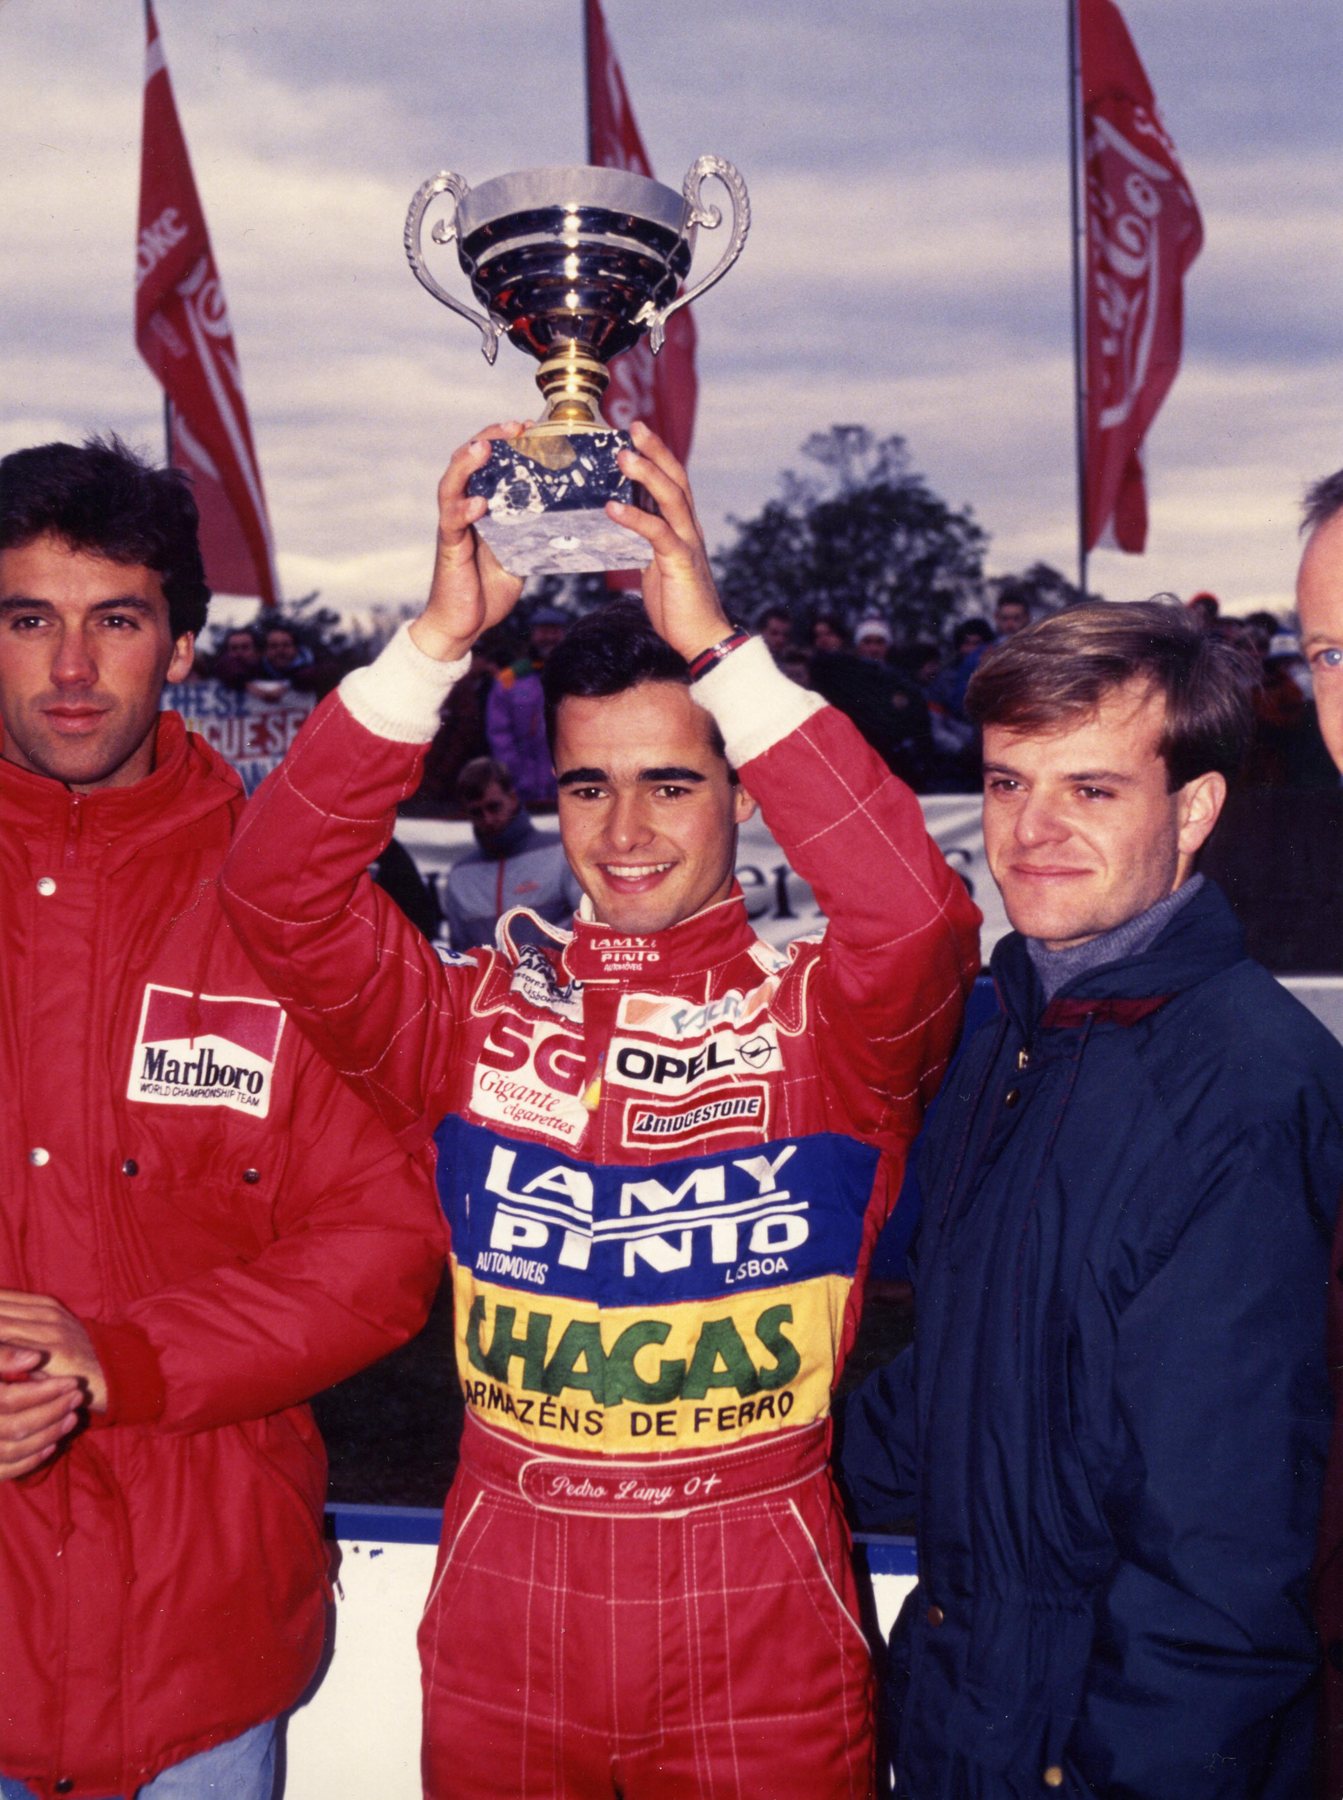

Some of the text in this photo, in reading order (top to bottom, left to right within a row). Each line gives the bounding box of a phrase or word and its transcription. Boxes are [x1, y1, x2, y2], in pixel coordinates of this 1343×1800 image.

[590, 938, 650, 950] LAMY
[601, 950, 660, 962] PINTO
[141, 1046, 264, 1094] Marlboro
[480, 1011, 586, 1097] SG
[616, 1042, 735, 1085] OPEL
[140, 1082, 260, 1107] WORLD CHAMPIONSHIP TEAM
[479, 1070, 561, 1112] Gigante
[503, 1103, 576, 1135] cigarettes
[634, 1098, 760, 1133] BRIDGESTONE
[485, 1145, 797, 1217] LAMY
[490, 1211, 809, 1277] PINTO
[466, 1295, 801, 1408] CHAGAS
[466, 1380, 795, 1436] ARMAZÉNS DE FERRO
[547, 1476, 607, 1497] Pedro
[614, 1480, 676, 1505] Lamy
